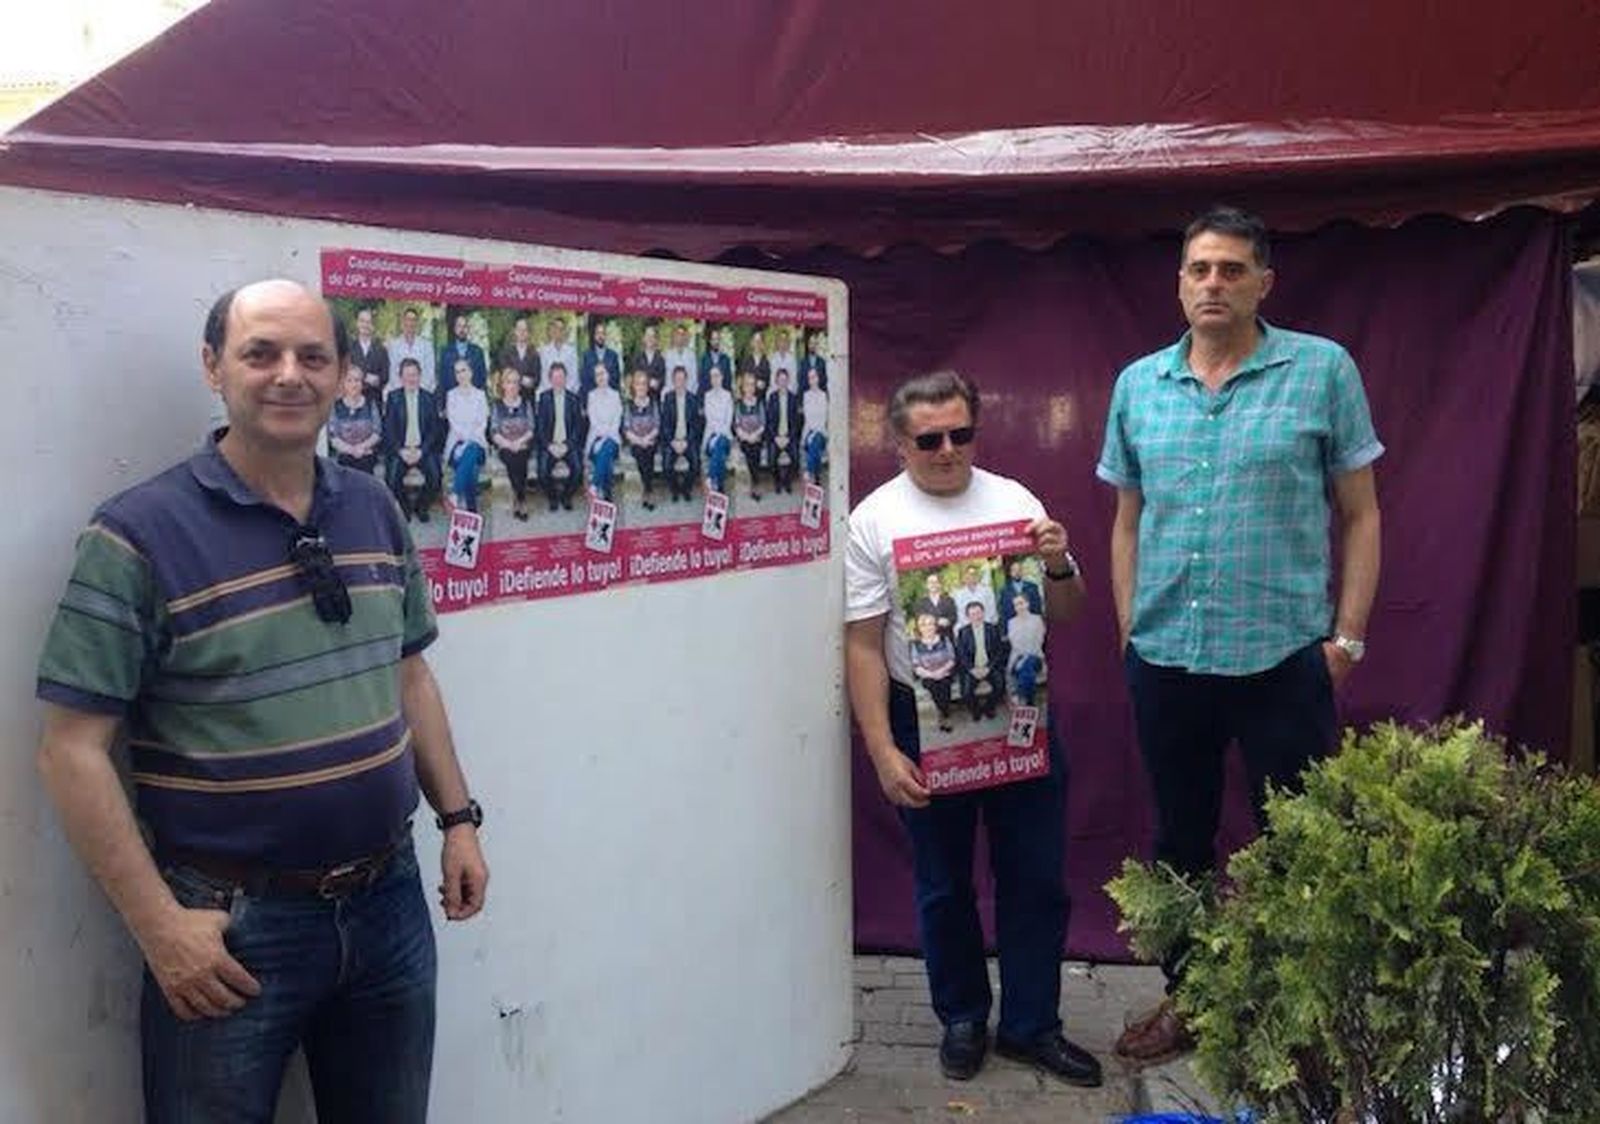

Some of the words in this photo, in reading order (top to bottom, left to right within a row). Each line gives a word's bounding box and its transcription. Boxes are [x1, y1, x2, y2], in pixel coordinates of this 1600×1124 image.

[348, 255, 411, 274] Candidatura
[415, 264, 465, 278] zamorana
[328, 271, 343, 286] de
[345, 273, 368, 288] UPL
[383, 277, 435, 294] Congreso
[436, 284, 443, 296] y
[445, 281, 482, 297] Senado
[500, 562, 568, 594] ¡Defiende
[571, 561, 585, 584] lo
[587, 556, 622, 585] tuyo!
[629, 549, 687, 577] ¡Defiende
[690, 547, 702, 568] lo
[703, 543, 733, 570] tuyo!
[428, 578, 444, 603] lo
[447, 572, 489, 604] tuyo!
[993, 757, 1008, 776] lo
[1009, 747, 1045, 775] tuyo!
